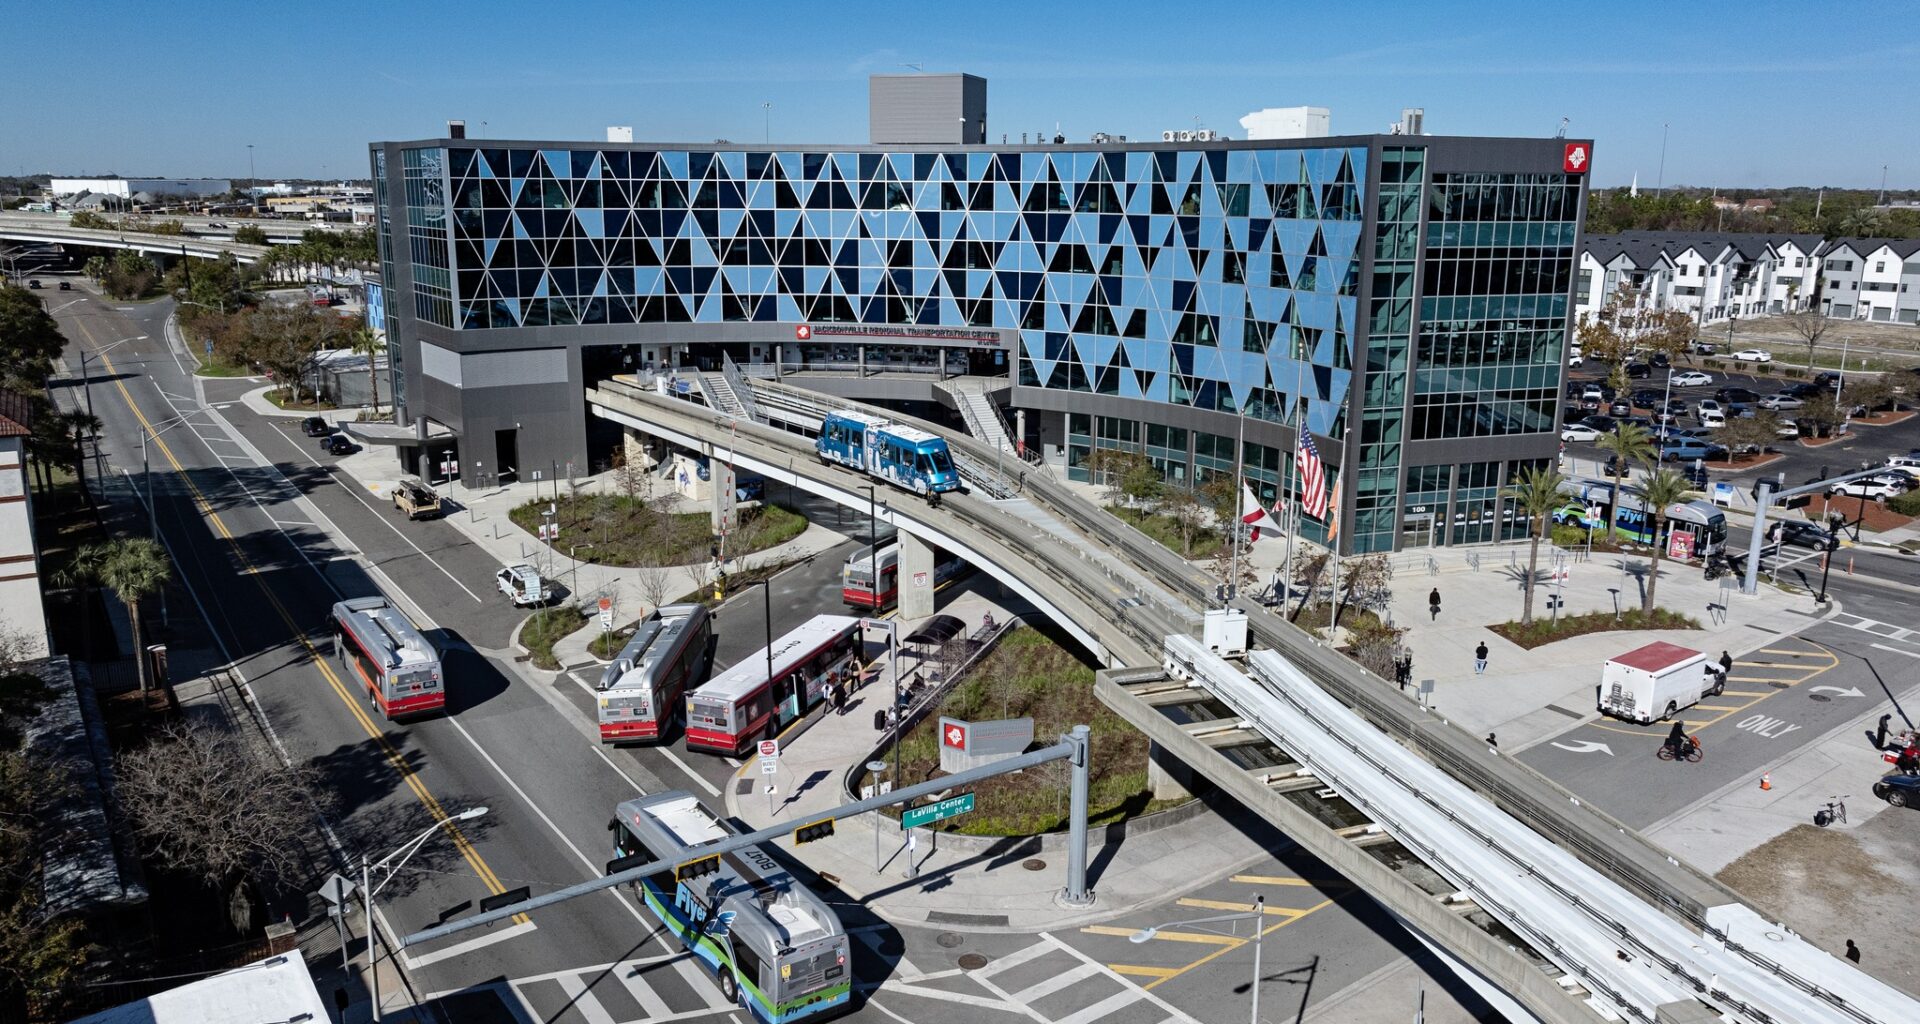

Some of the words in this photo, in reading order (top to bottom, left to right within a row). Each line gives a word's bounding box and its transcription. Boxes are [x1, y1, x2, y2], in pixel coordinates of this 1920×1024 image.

[814, 325, 868, 334] JACKSONVILLE
[869, 327, 904, 336] REGIONAL
[907, 328, 970, 338] TRANSPORTATION
[971, 330, 1000, 339] CENTER
[1736, 714, 1803, 739] ONLY
[912, 806, 938, 818] LaVilla
[940, 798, 966, 810] Center
[935, 812, 944, 820] DR
[744, 851, 777, 871] B047
[675, 881, 708, 923] Flyer
